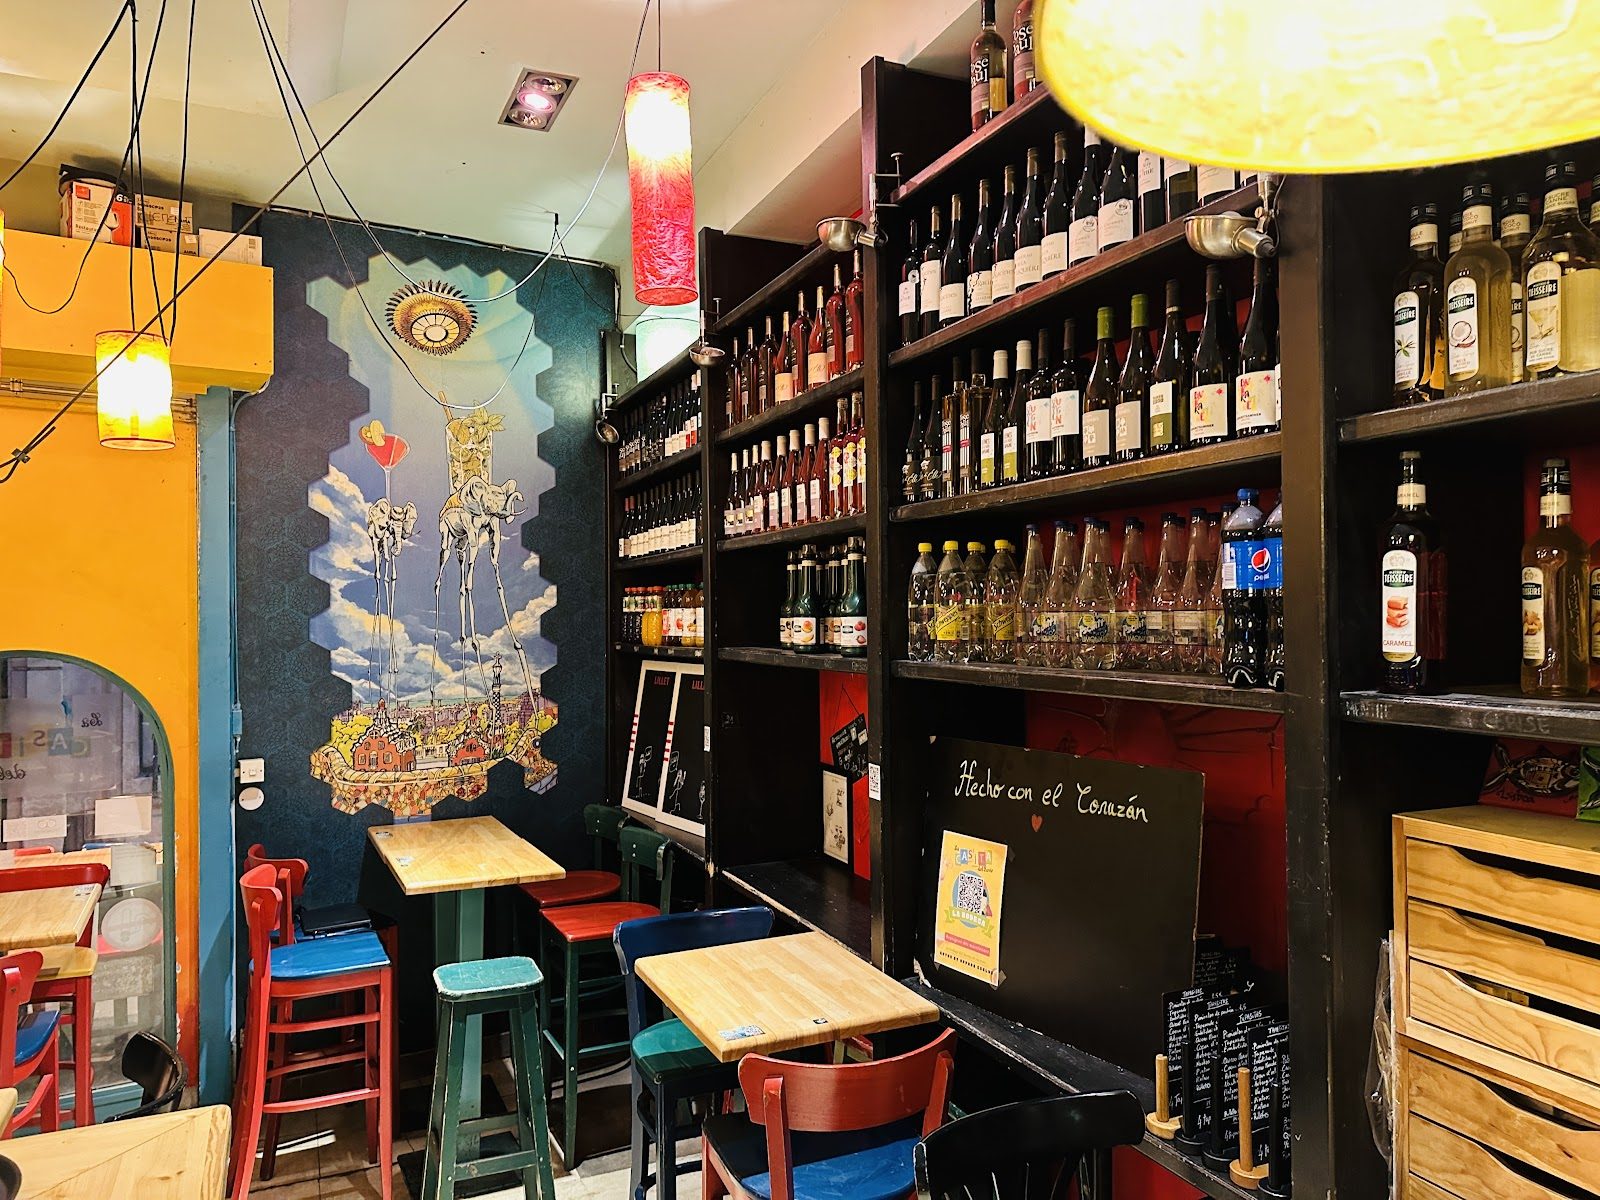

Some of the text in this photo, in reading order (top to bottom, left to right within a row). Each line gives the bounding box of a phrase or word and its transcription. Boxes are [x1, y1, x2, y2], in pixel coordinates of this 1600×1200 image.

[1384, 572, 1414, 584] TEISSEIRE
[1383, 639, 1414, 648] CARAMEL
[955, 759, 1005, 798] Hecho
[1007, 785, 1033, 802] con
[1041, 782, 1063, 807] el
